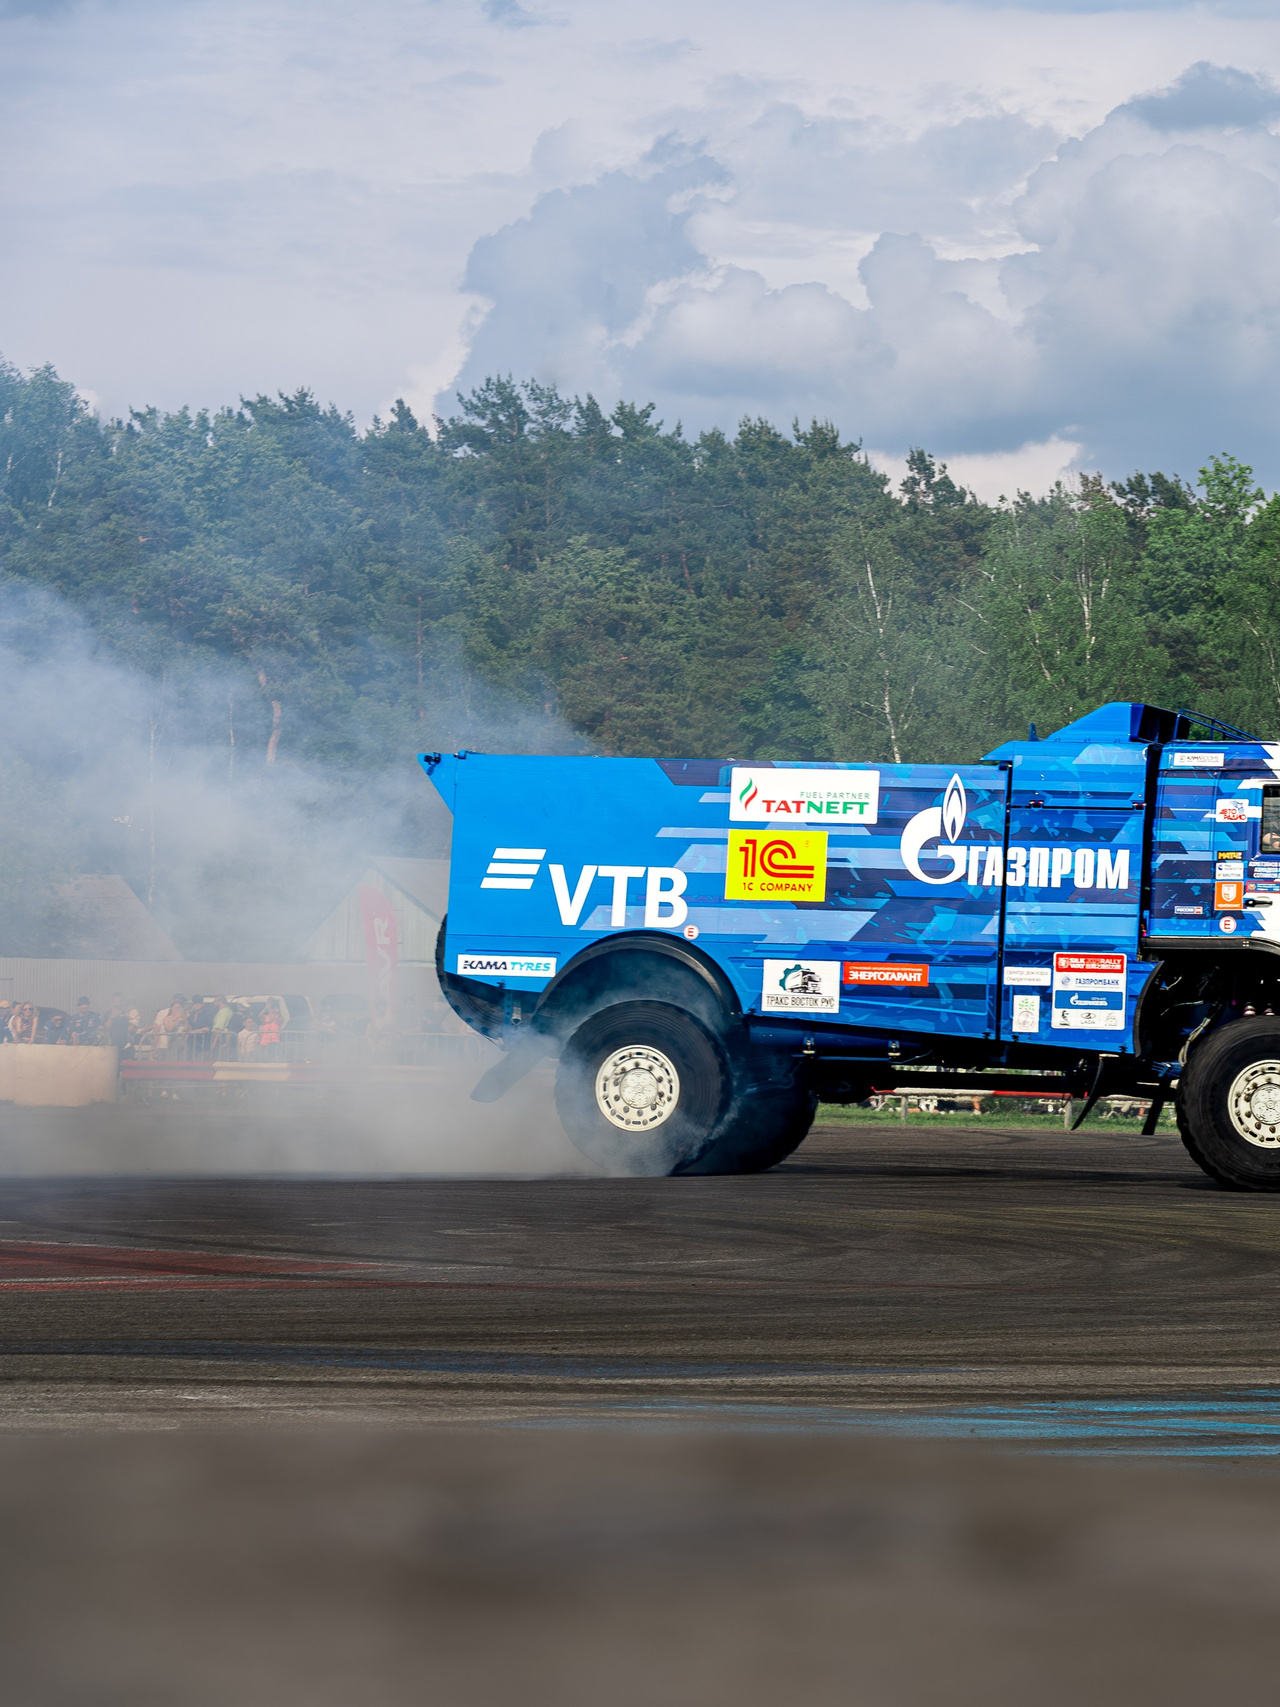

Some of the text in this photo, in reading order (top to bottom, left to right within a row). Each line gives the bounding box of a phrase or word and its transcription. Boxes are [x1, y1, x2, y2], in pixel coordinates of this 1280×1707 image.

[800, 791, 870, 800] FUEL PARTNER
[762, 800, 869, 815] TATNEFT
[967, 845, 1130, 890] ГАЗПРОМ
[760, 882, 813, 892] COMPANY
[548, 863, 688, 928] VTB
[1224, 919, 1231, 930] E
[687, 928, 695, 937] E
[510, 962, 551, 972] TYRES
[848, 970, 923, 982] ЭНЕРГОГАРАНТ
[1075, 978, 1120, 986] ГАЗПРОМБАНК
[766, 996, 835, 1008] ТРАКС ВОСТОК РУС
